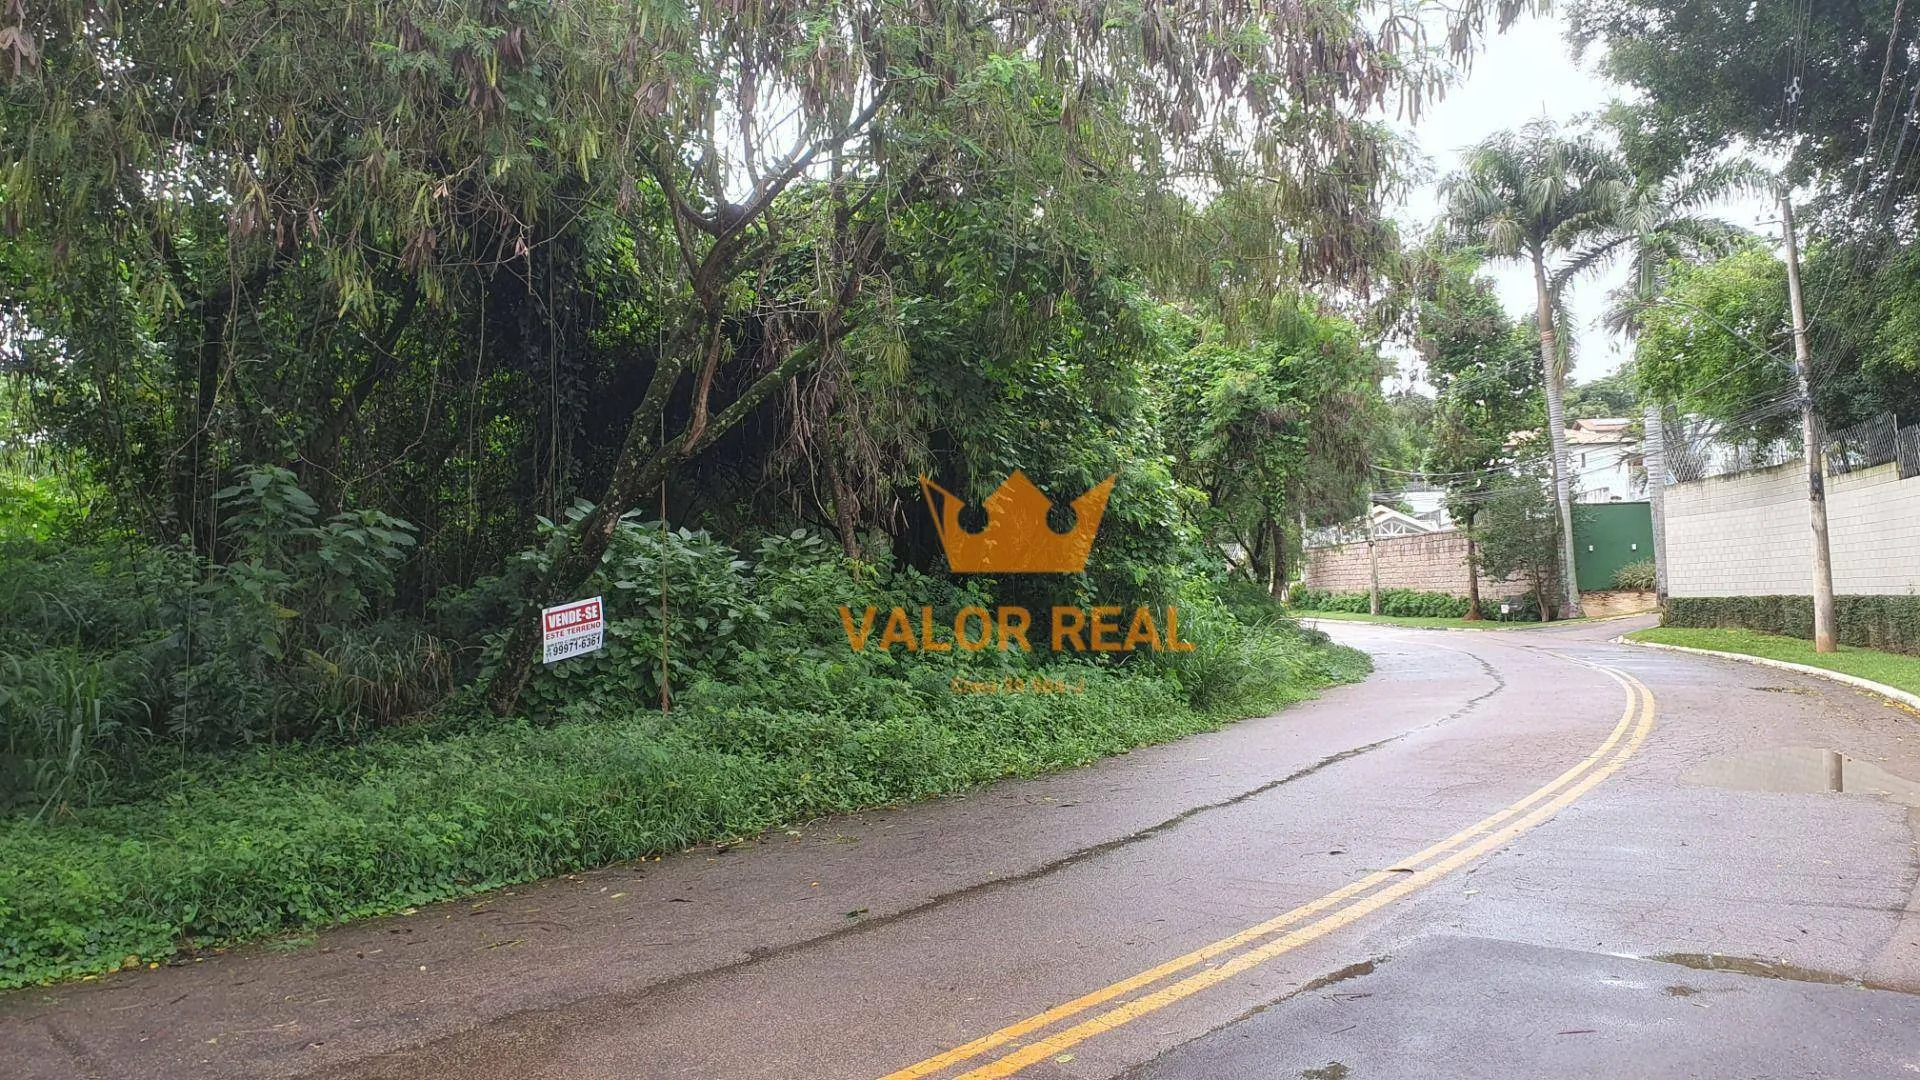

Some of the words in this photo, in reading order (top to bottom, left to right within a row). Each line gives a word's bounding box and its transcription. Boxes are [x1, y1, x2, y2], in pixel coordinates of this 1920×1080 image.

[548, 605, 598, 628] VENDE-SE
[545, 631, 565, 640] ESTE
[567, 621, 601, 635] TERRENO
[553, 635, 600, 656] 99971-6361
